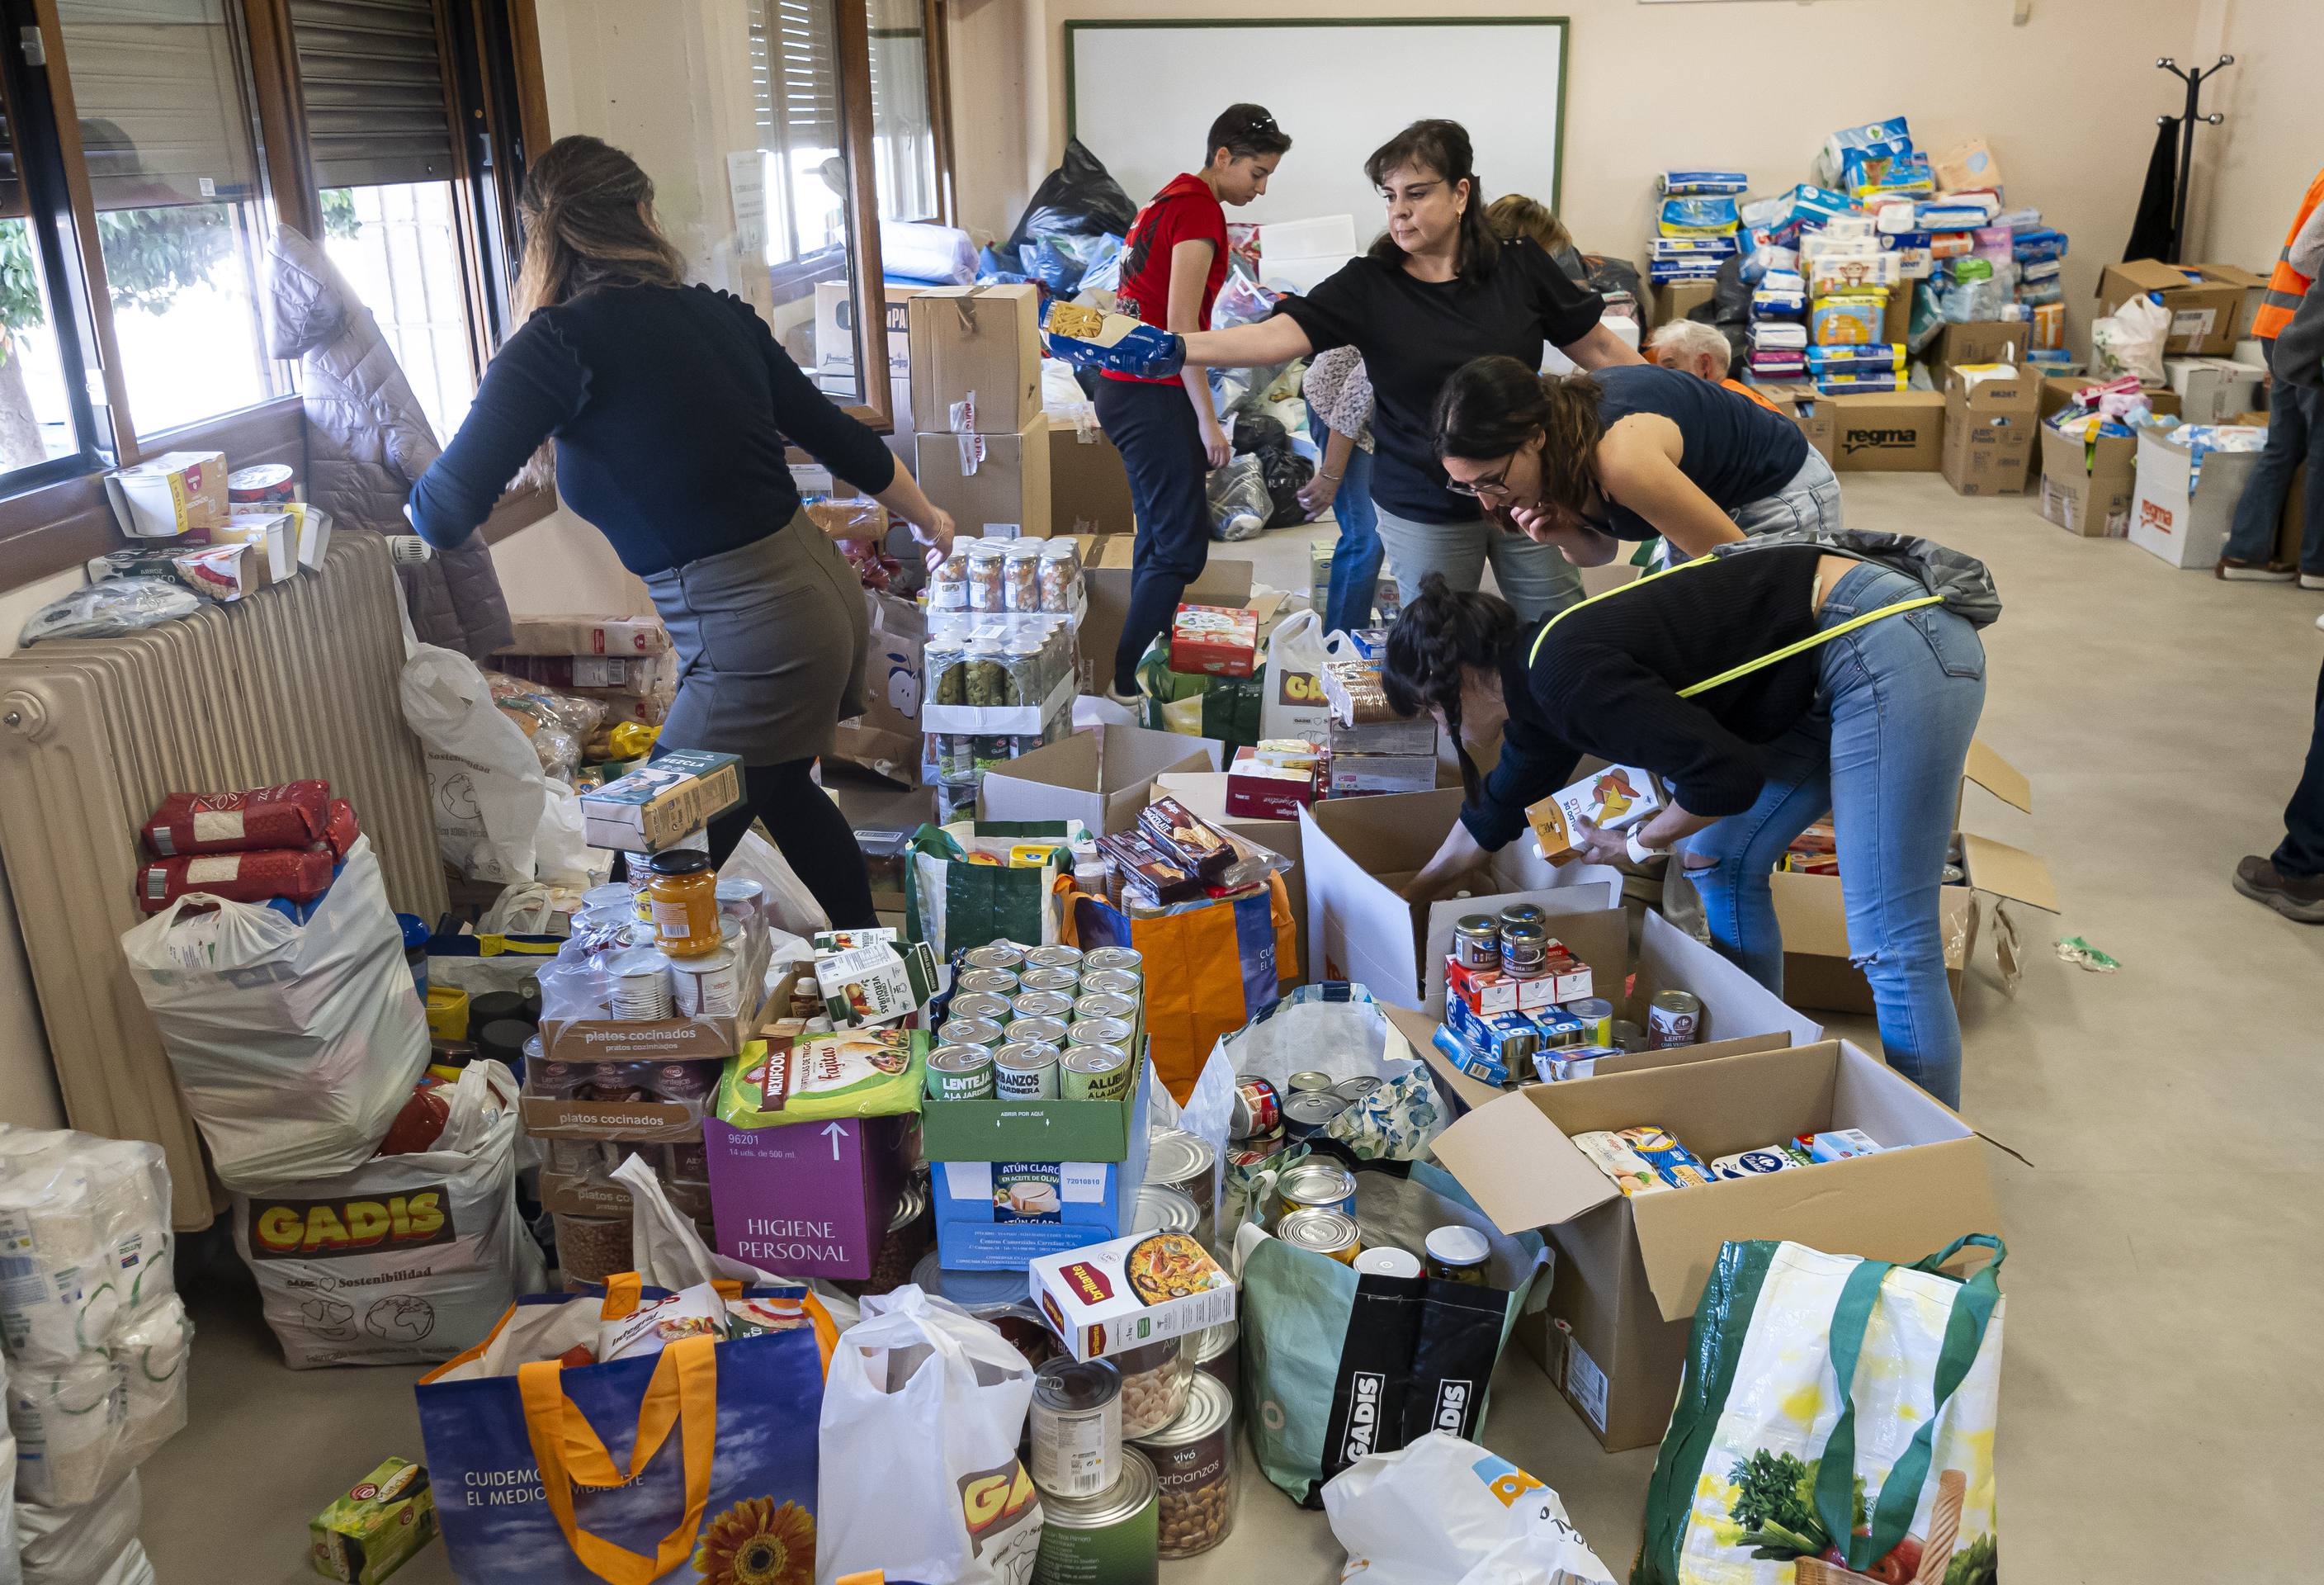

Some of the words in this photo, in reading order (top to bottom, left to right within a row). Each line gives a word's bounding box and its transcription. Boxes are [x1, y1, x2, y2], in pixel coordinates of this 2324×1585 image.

[1847, 429, 1916, 445] regma
[2142, 499, 2172, 527] regma
[659, 757, 706, 769] MEZCLA
[1142, 810, 1172, 832] CHOCOLATE
[872, 976, 890, 1015] VERDURAS
[586, 1031, 626, 1044] platos
[628, 1029, 697, 1042] cocinados
[606, 1044, 631, 1053] pratos
[802, 1040, 812, 1058] TRIGO
[767, 1051, 786, 1097] MEXIFOOD
[942, 1071, 990, 1091] LENTEJA
[995, 1073, 1039, 1087] RBANZOS
[560, 1113, 598, 1125] platos
[601, 1114, 664, 1127] cocinados
[728, 1133, 759, 1145] 96201
[1003, 1162, 1028, 1174] ATÚN
[257, 1192, 445, 1251] GADIS
[748, 1218, 836, 1238] HIGIENE
[739, 1241, 850, 1262] PERSONAL
[338, 1266, 432, 1289] Sostenibilidad
[1072, 1265, 1105, 1302] brillante
[1092, 1324, 1100, 1356] brillante
[1346, 1377, 1379, 1463] GADIS
[465, 1468, 543, 1487] CUIDEMO
[1158, 1460, 1219, 1485] arbanzos
[467, 1491, 484, 1507] EL
[490, 1486, 548, 1506] MEDIO
